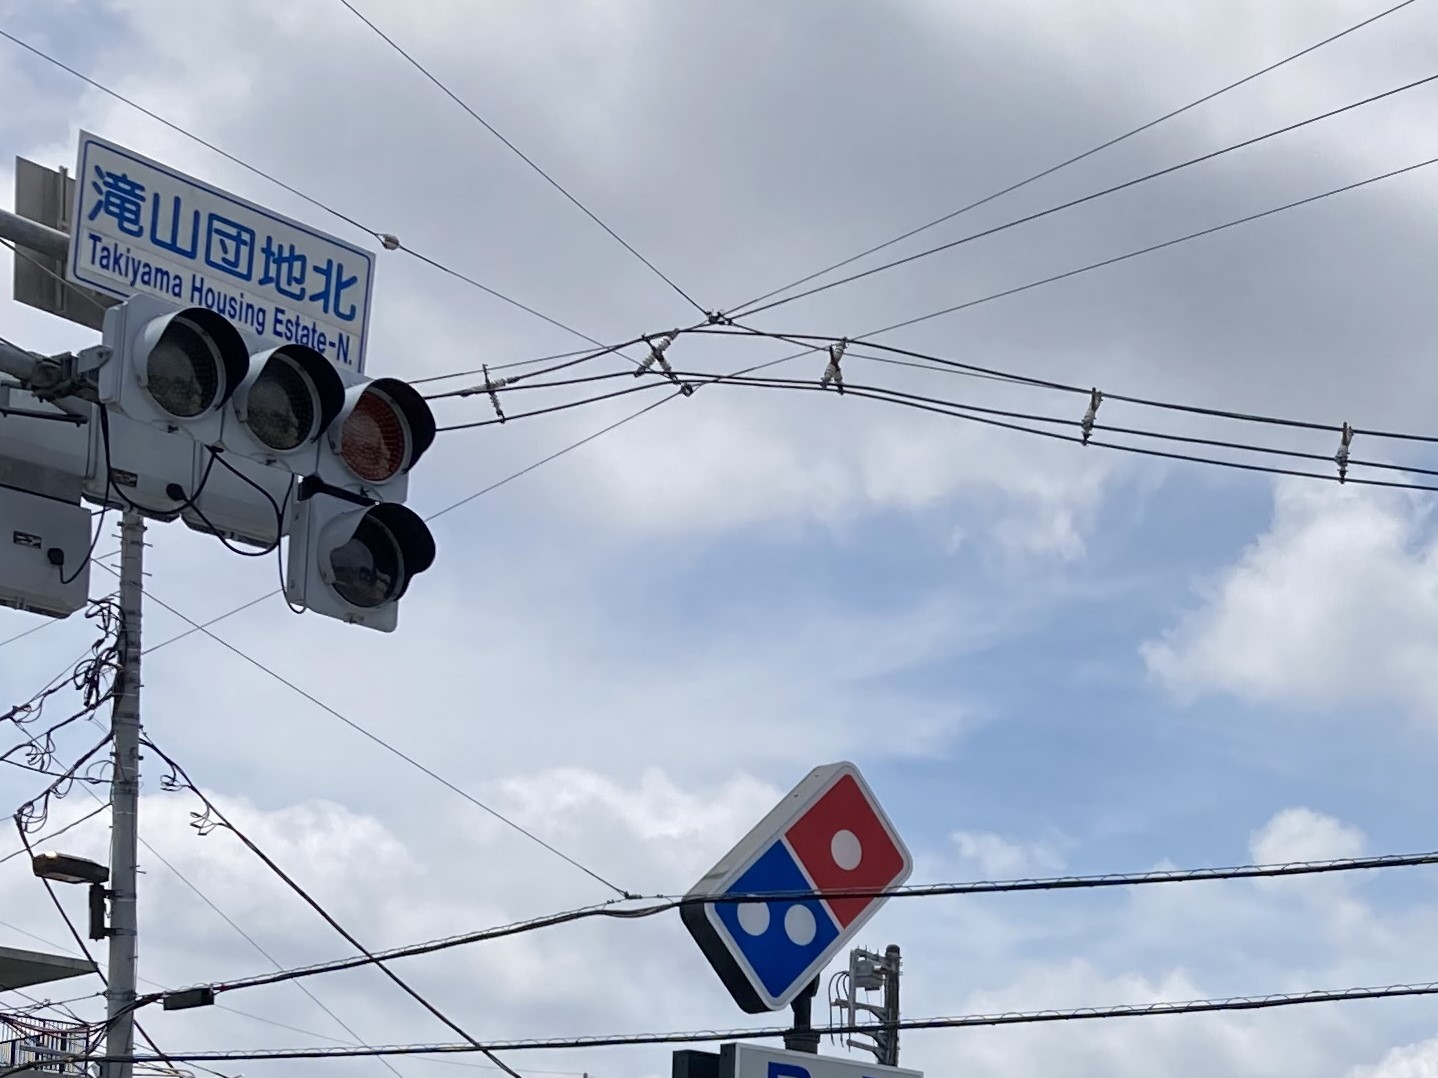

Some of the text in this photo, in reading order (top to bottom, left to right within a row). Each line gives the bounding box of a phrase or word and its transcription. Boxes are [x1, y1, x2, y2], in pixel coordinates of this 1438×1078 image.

[88, 165, 358, 321] 滝山団地北
[89, 233, 353, 365] Takiyama Housing Estate-N.
